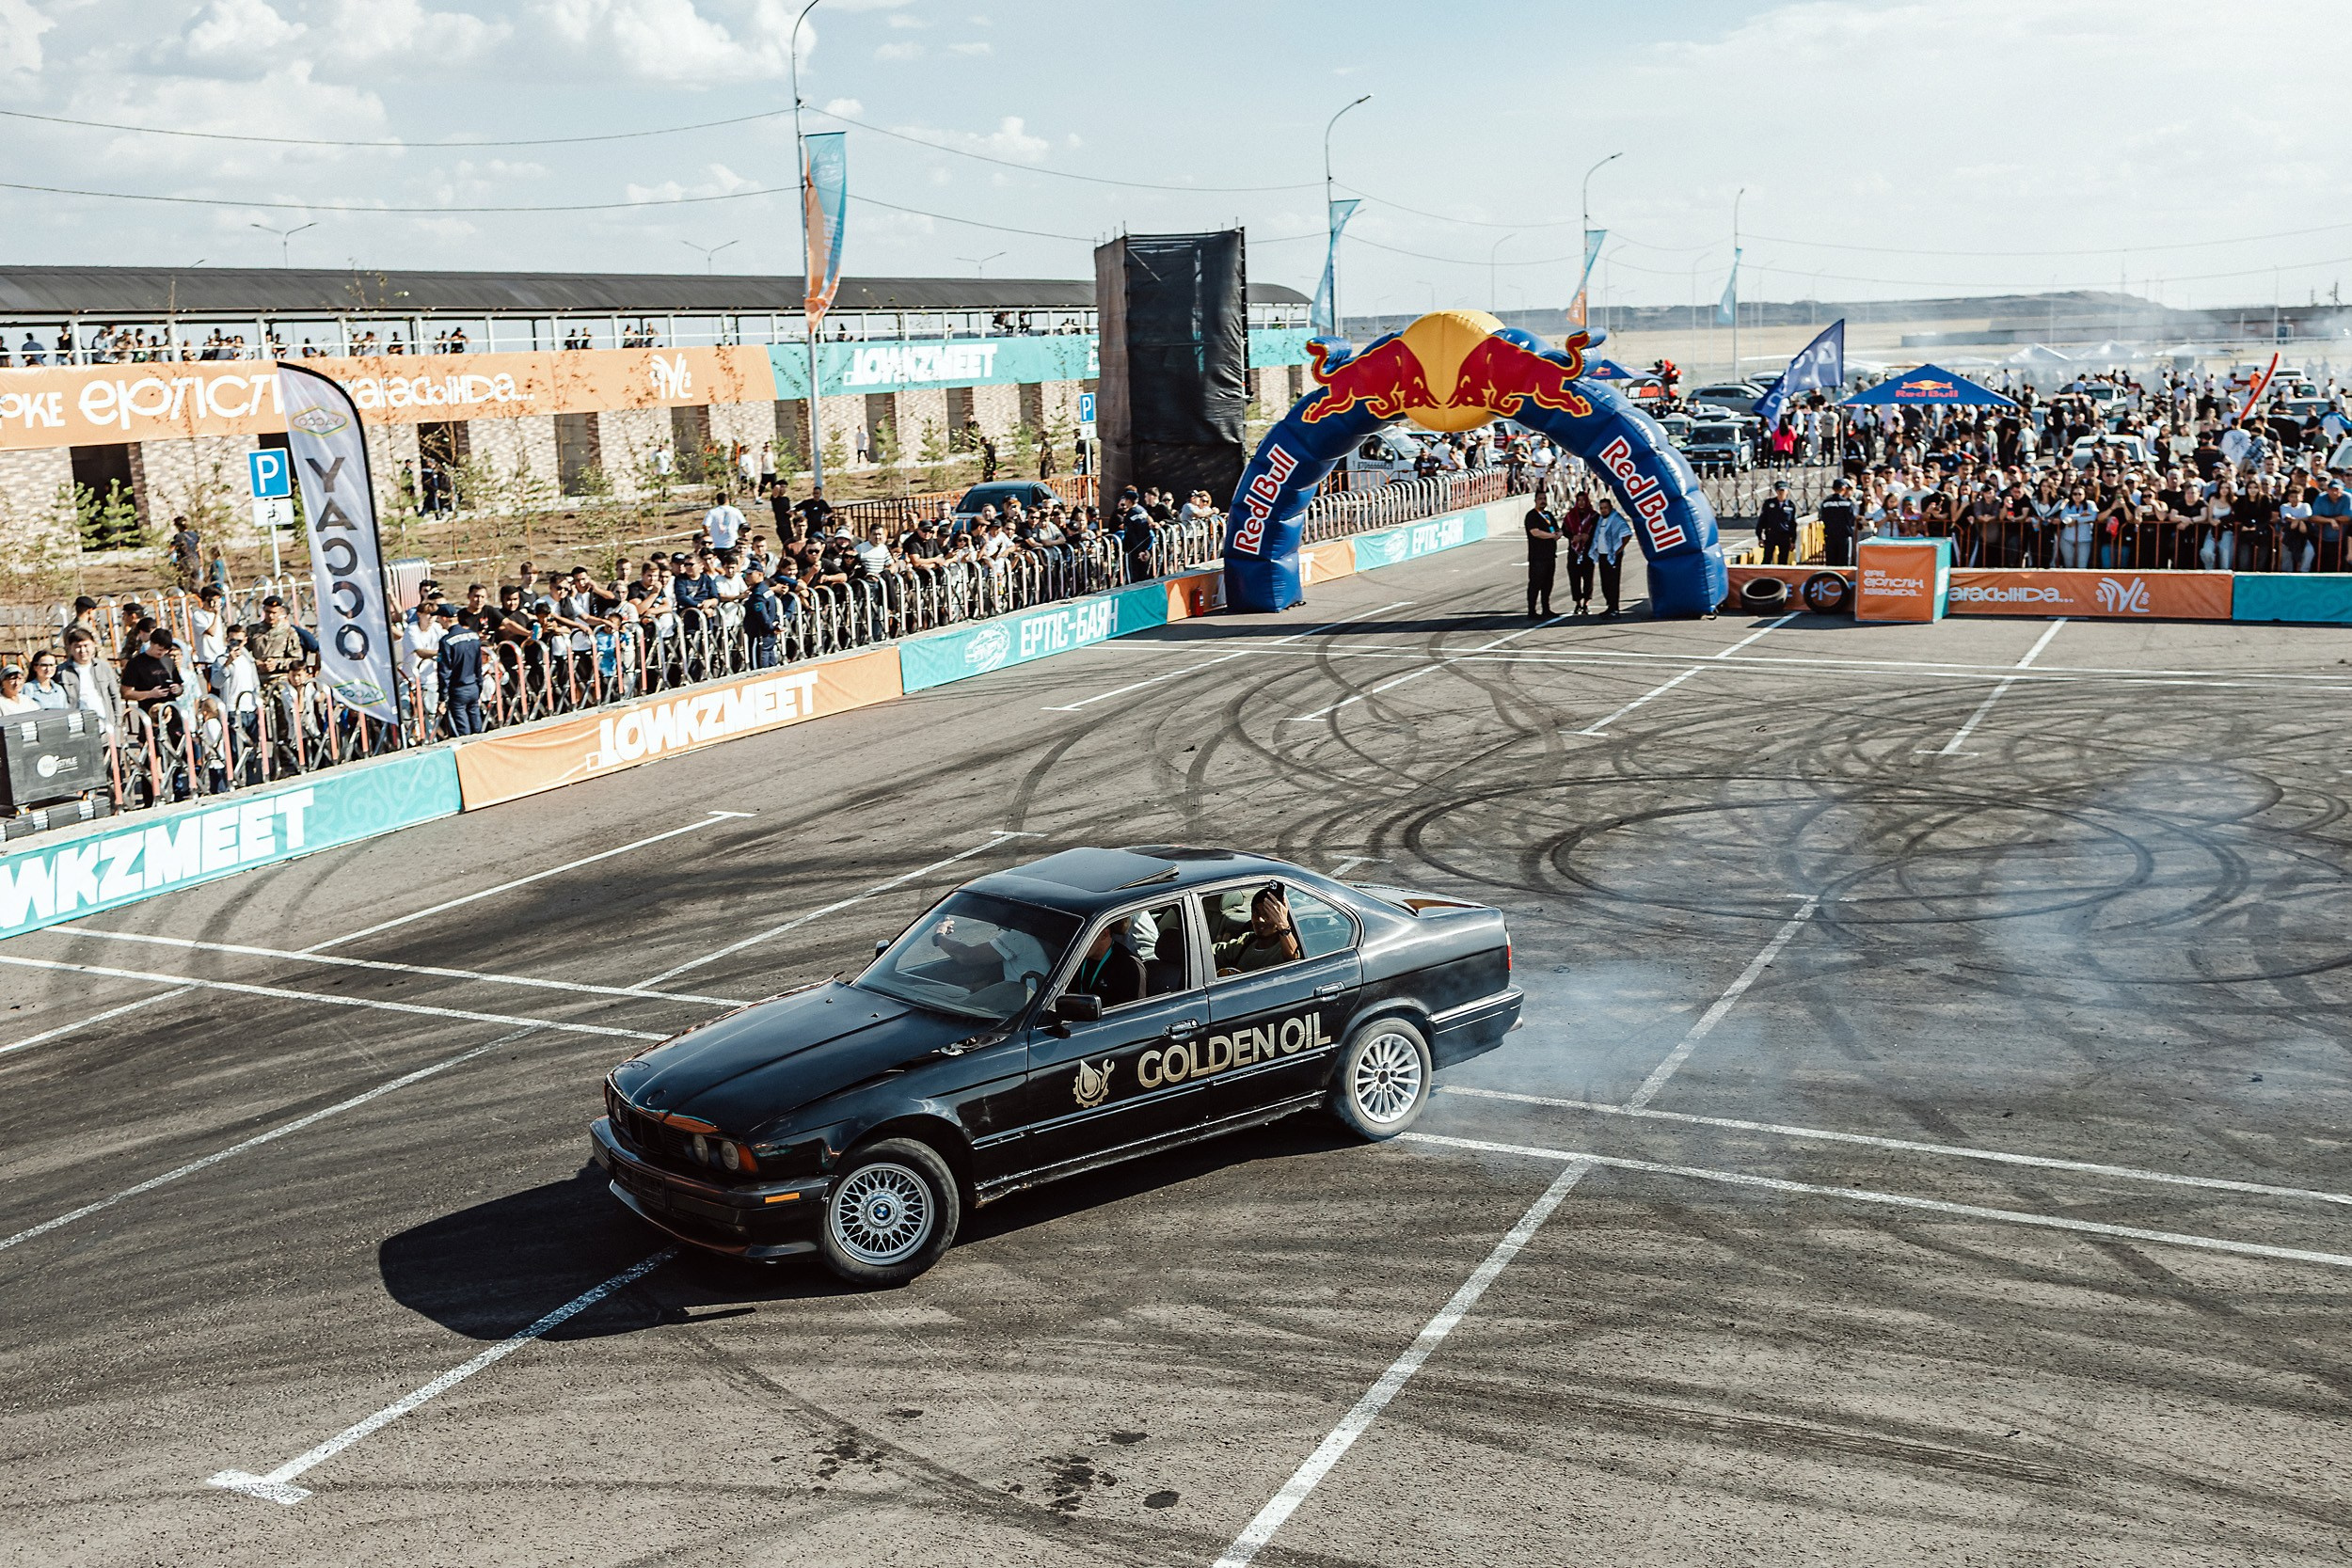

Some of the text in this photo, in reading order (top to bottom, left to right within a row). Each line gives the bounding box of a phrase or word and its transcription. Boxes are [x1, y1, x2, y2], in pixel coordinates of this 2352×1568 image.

[1081, 396, 1092, 420] P
[1895, 389, 1959, 398] Red Bull
[256, 454, 279, 494] P
[1233, 445, 1296, 554] Red Bull
[1600, 437, 1658, 499] Red
[1636, 491, 1684, 550] Bull
[586, 670, 818, 771] LOWKZMEET
[1137, 1011, 1332, 1088] GOLDEN OIL
